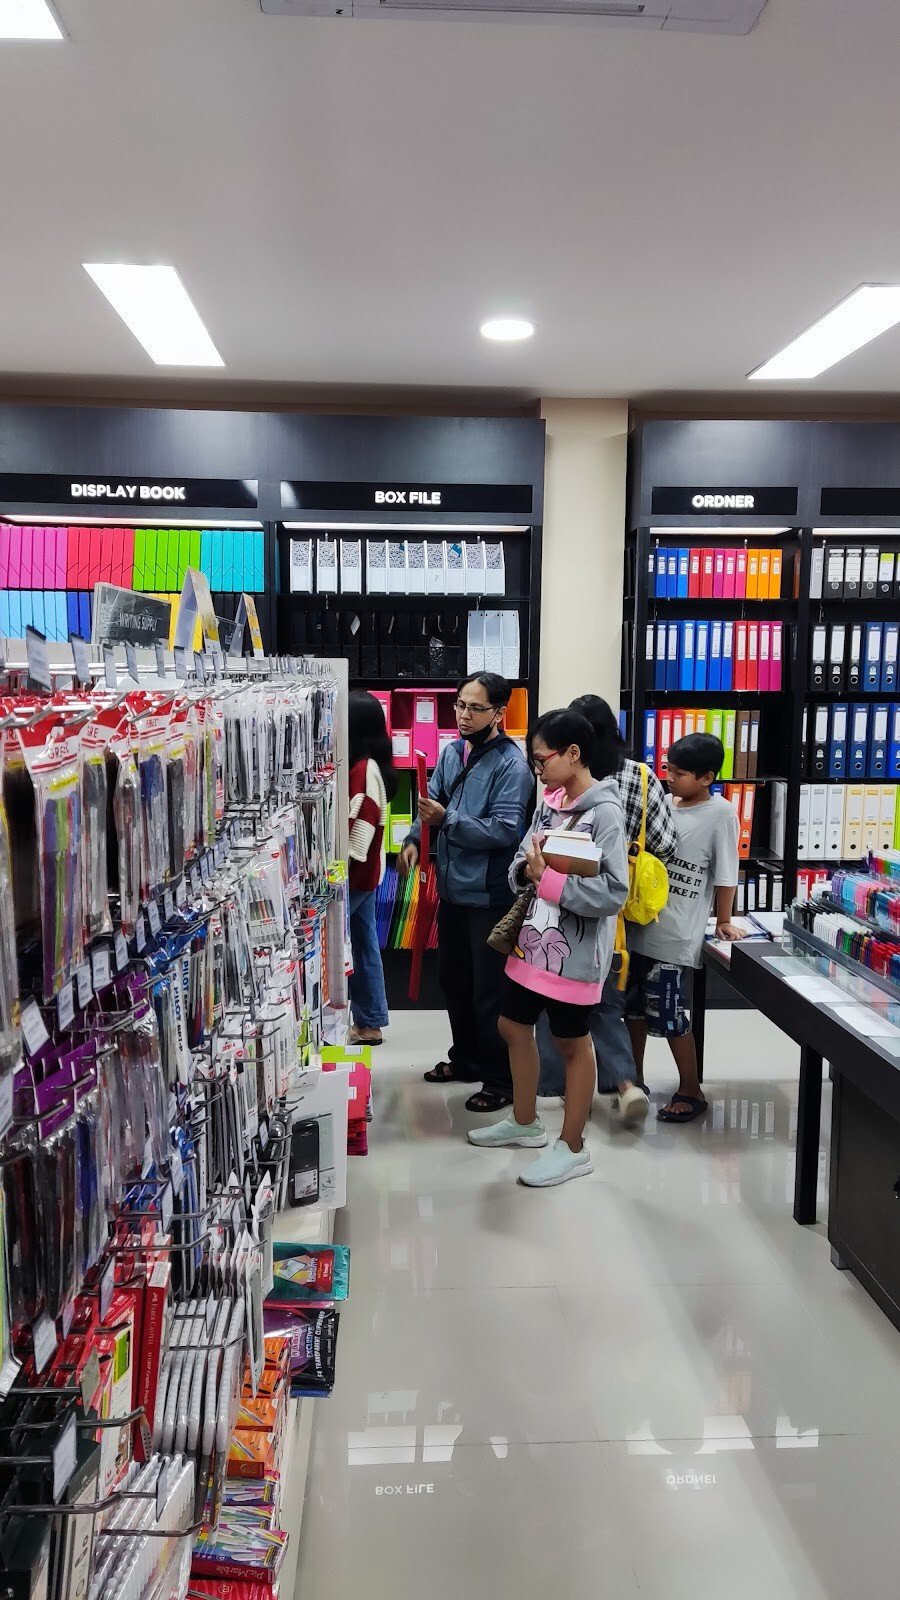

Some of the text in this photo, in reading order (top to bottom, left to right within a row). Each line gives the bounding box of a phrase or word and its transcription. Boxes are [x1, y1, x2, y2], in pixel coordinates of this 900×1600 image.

[71, 482, 185, 500] DISPLAY BOOK
[374, 490, 442, 505] BOX FILE
[692, 493, 755, 509] ORDNER
[119, 612, 158, 632] WRITING SUPPLY
[669, 885, 689, 897] IKE
[306, 1326, 315, 1358] EXCLUSIVE
[313, 1335, 322, 1370] TRANSPARENT
[215, 1564, 265, 1580] PicMarble
